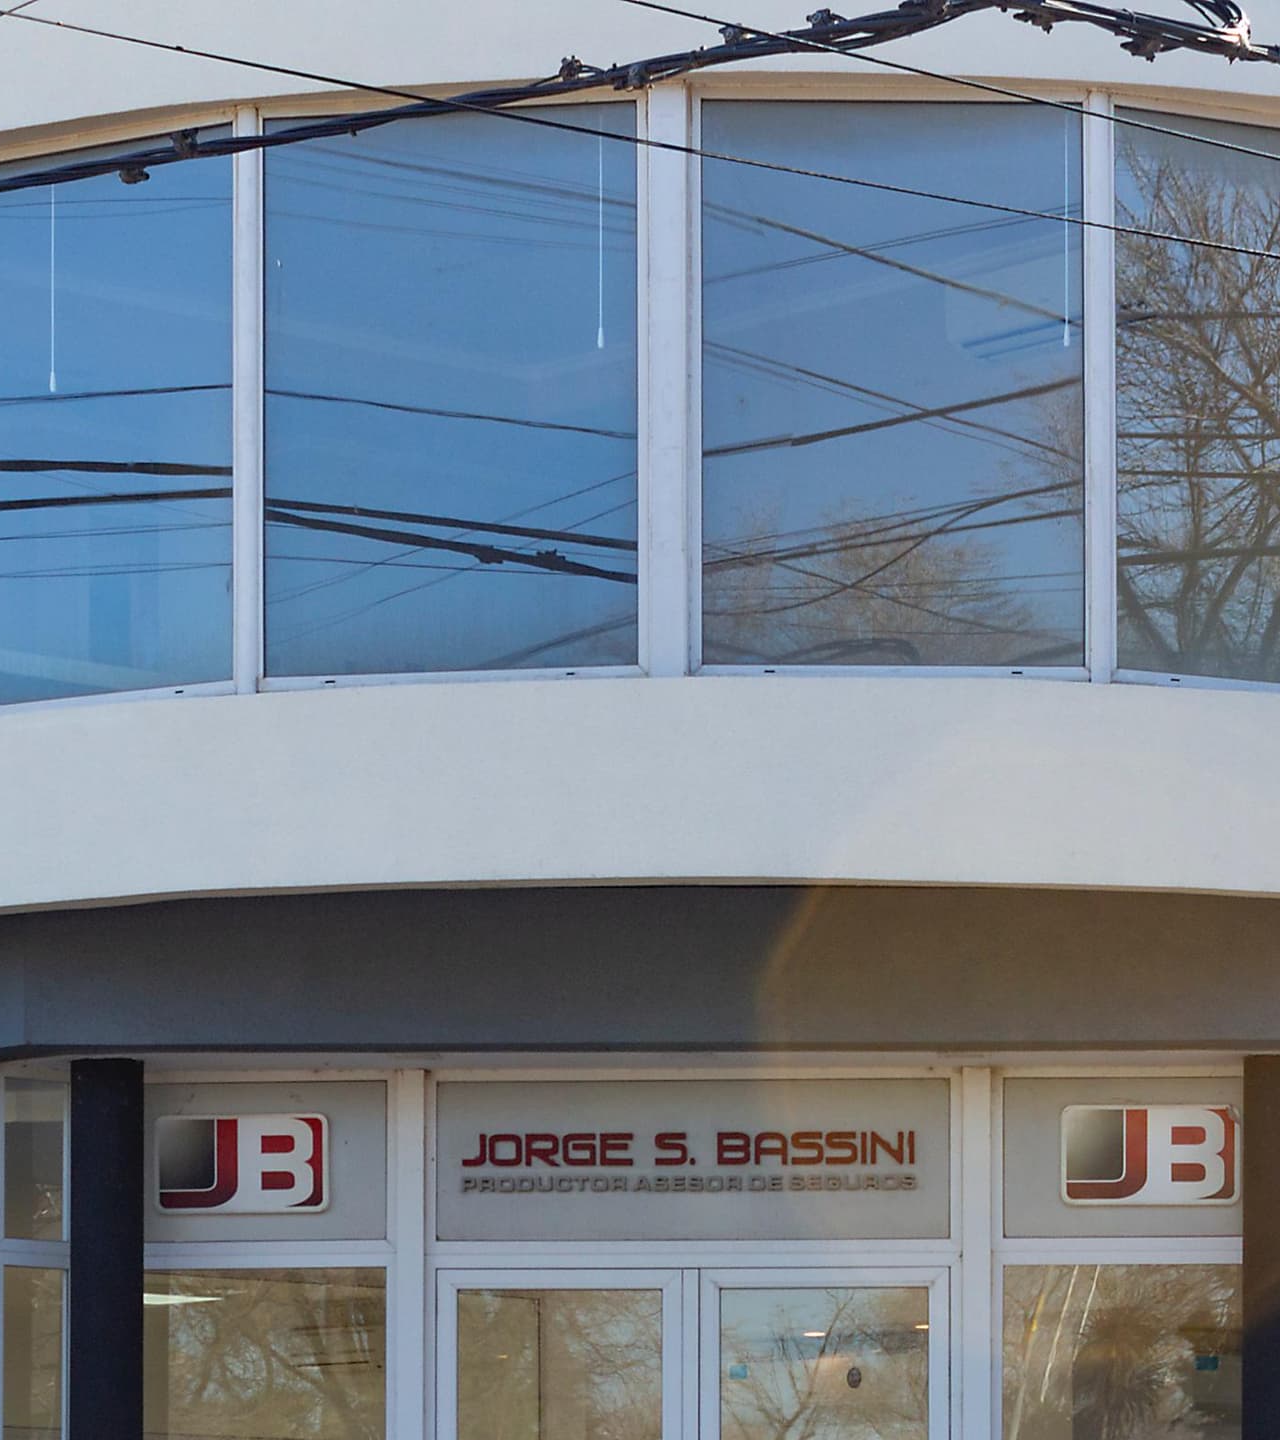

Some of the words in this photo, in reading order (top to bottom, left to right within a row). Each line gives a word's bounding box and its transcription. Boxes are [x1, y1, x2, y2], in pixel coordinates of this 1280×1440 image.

[462, 1133, 634, 1167] JORGE
[655, 1132, 696, 1167] S.
[717, 1130, 915, 1166] BASSINI
[463, 1176, 629, 1193] PRODUCTOR
[633, 1176, 744, 1193] ASESOR
[748, 1176, 784, 1192] DE
[788, 1174, 917, 1192] SEGUROS
